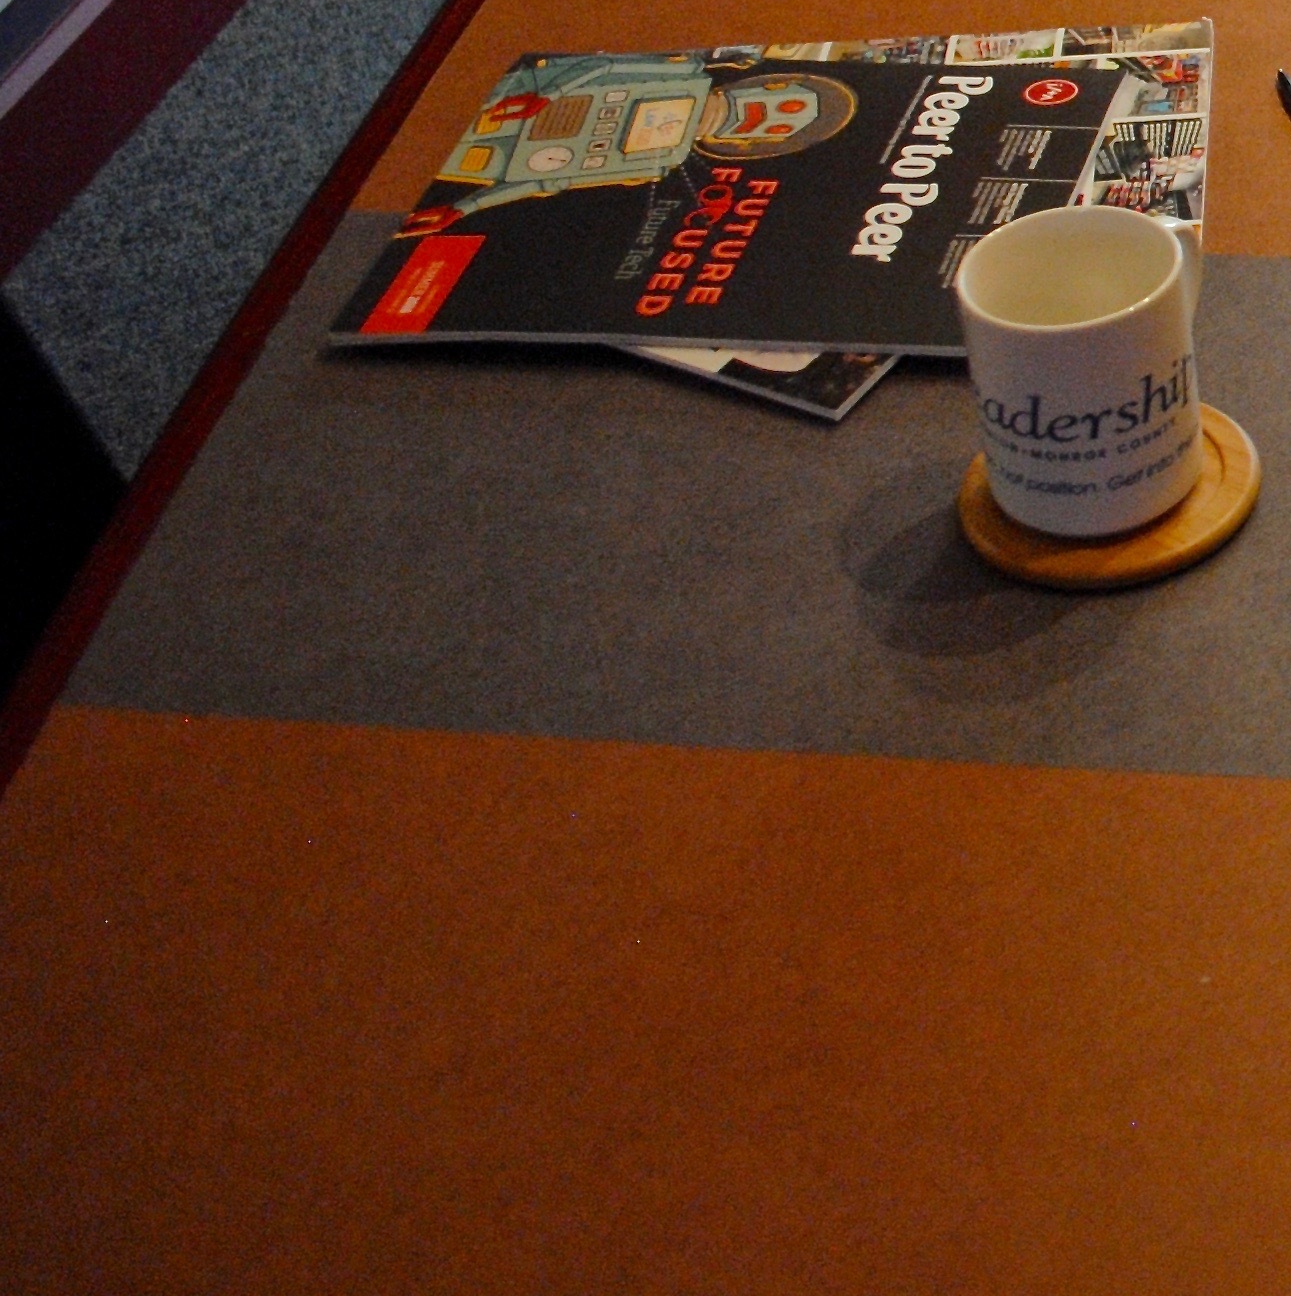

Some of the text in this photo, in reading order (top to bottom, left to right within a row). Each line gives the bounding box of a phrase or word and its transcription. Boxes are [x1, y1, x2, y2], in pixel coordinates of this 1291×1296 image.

[911, 76, 994, 142] Peer
[891, 143, 954, 179] to
[634, 166, 743, 317] FOCUSED
[635, 199, 682, 245] Future
[685, 179, 780, 305] FUTURE
[851, 182, 939, 263] Peer
[613, 245, 655, 281] Tech
[974, 355, 1192, 443] adershi
